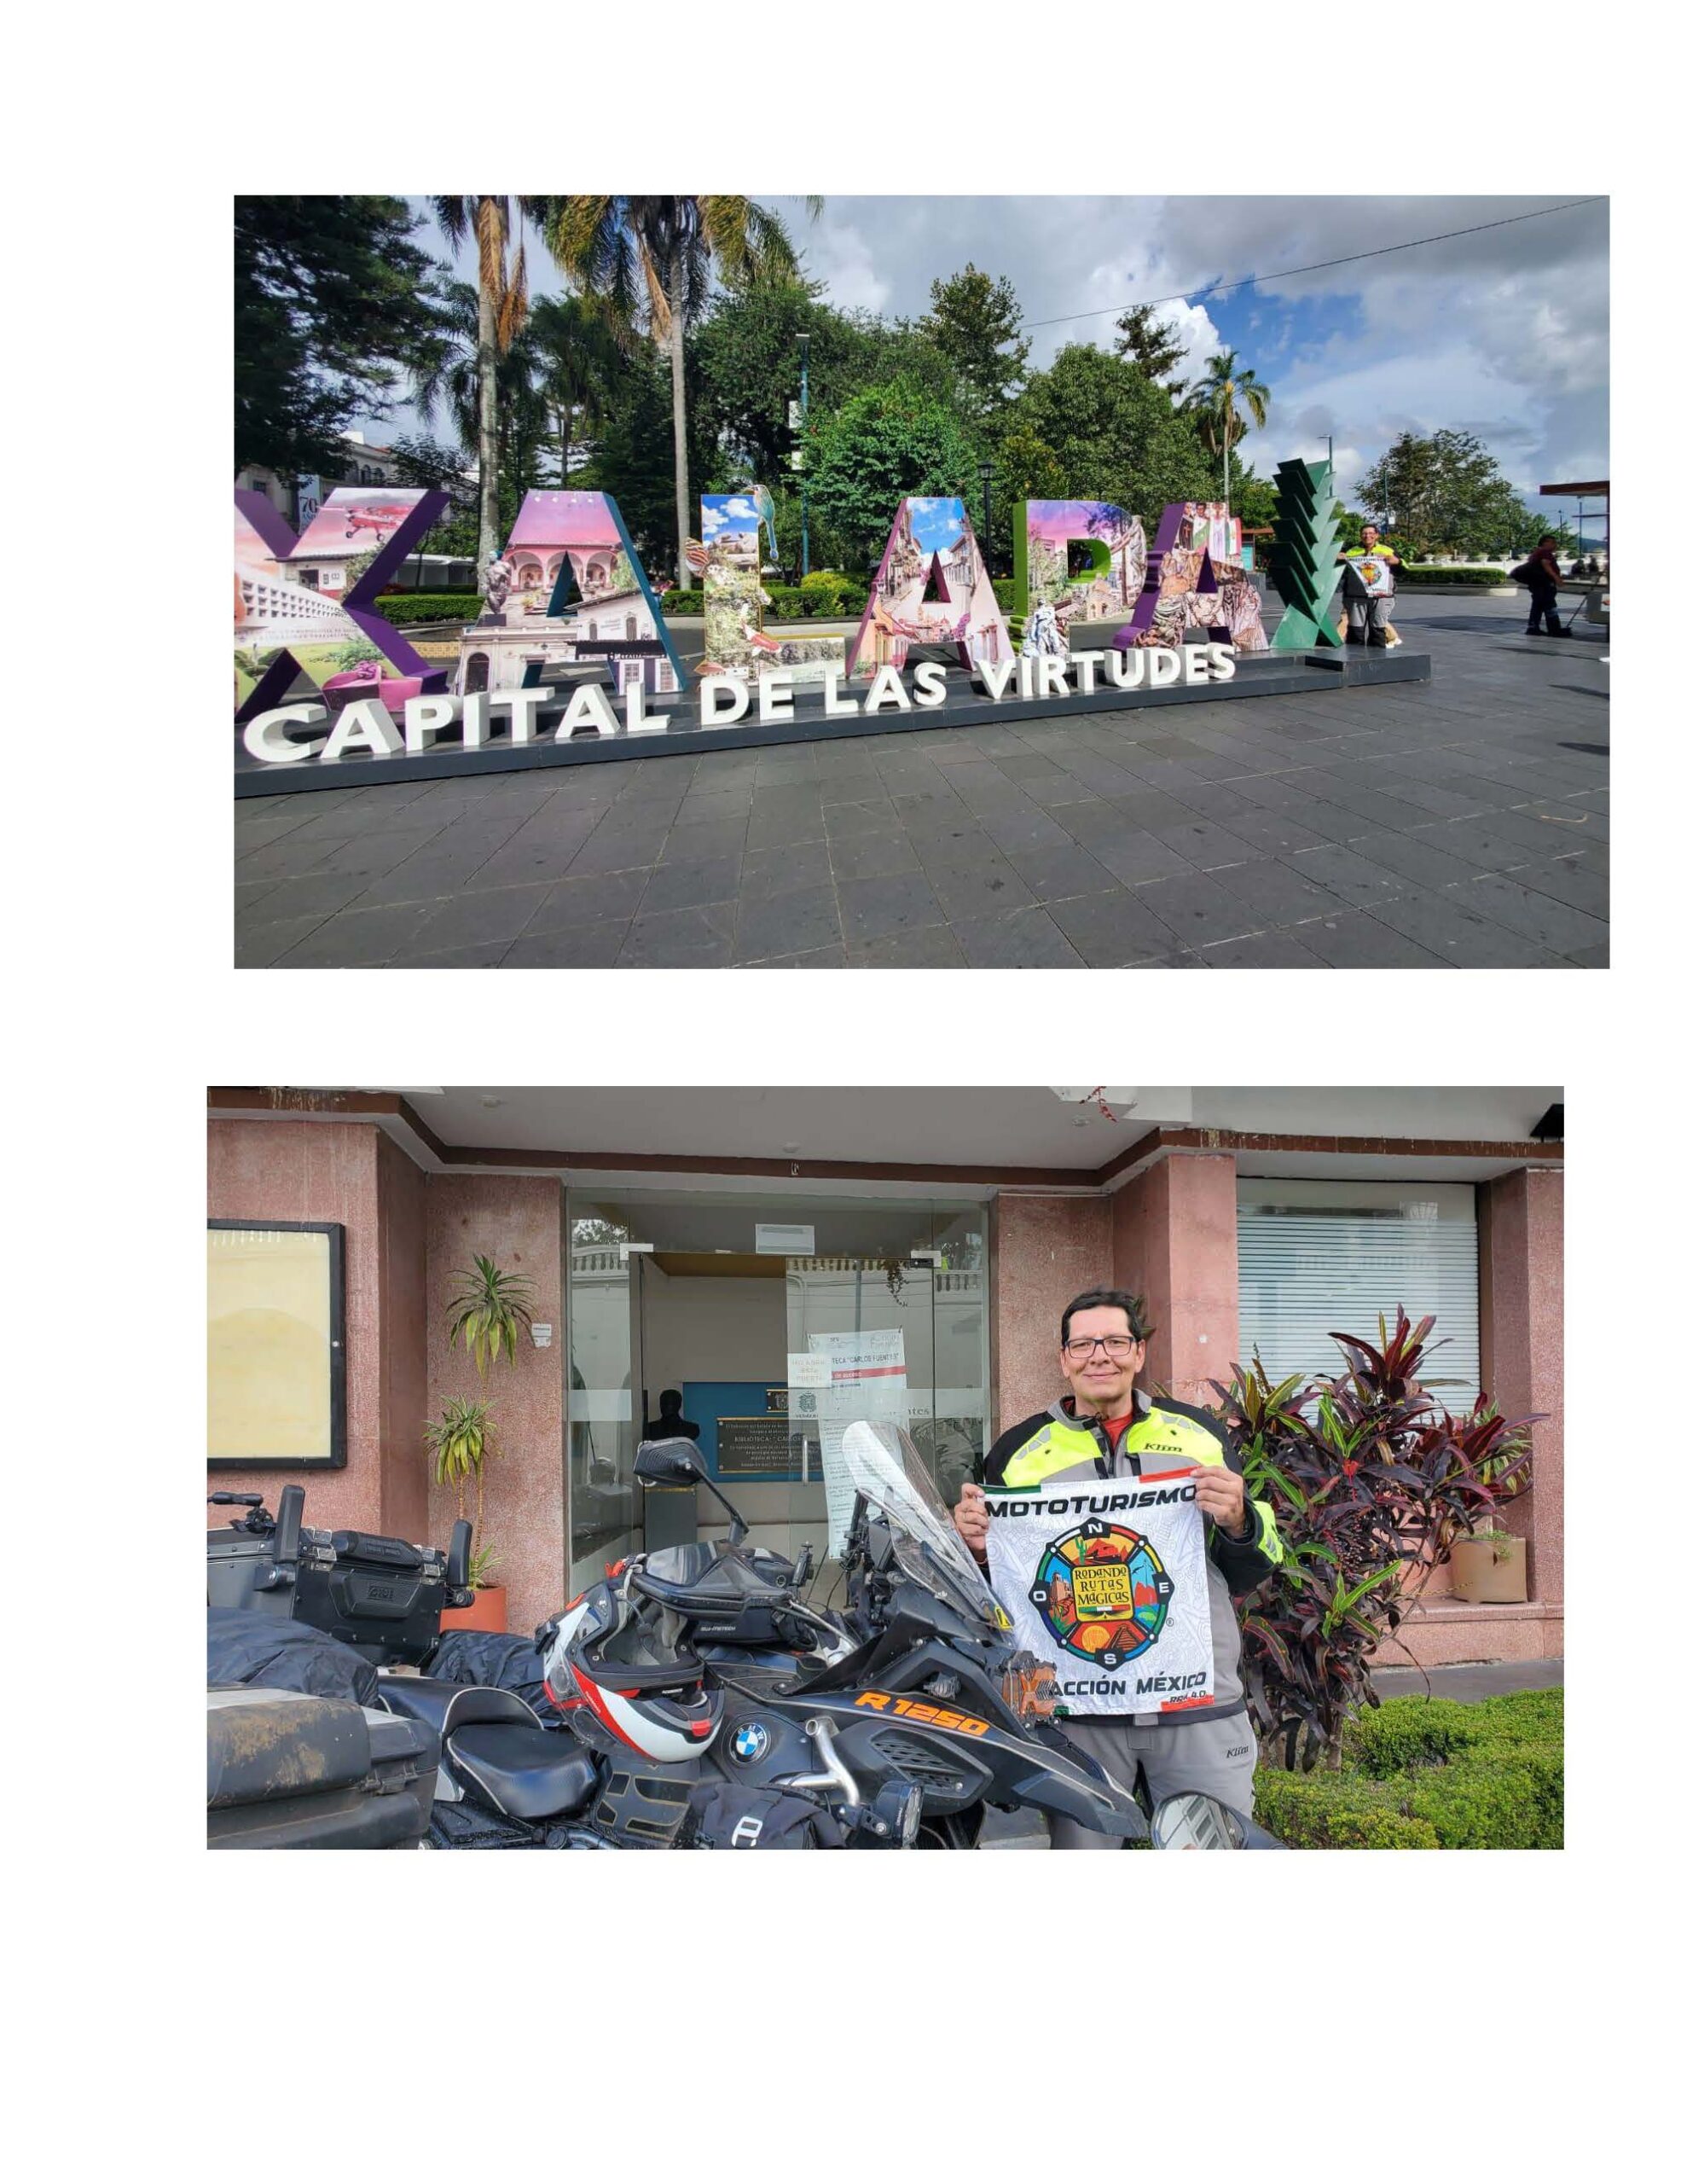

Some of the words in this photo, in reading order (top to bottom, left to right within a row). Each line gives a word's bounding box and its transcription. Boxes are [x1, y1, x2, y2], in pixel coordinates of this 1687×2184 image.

[242, 681, 672, 764] CAPITAL
[699, 668, 796, 726] DE
[824, 661, 948, 716] LAS
[973, 642, 1237, 701] VIRTUDES
[985, 1484, 1197, 1518] MOTOTURISMO
[1087, 1523, 1103, 1534] N
[1158, 1582, 1170, 1593] E
[1104, 1653, 1117, 1664] S
[1136, 1671, 1207, 1694] MÉXICO
[855, 1692, 891, 1711] R
[893, 1699, 990, 1736] 1250
